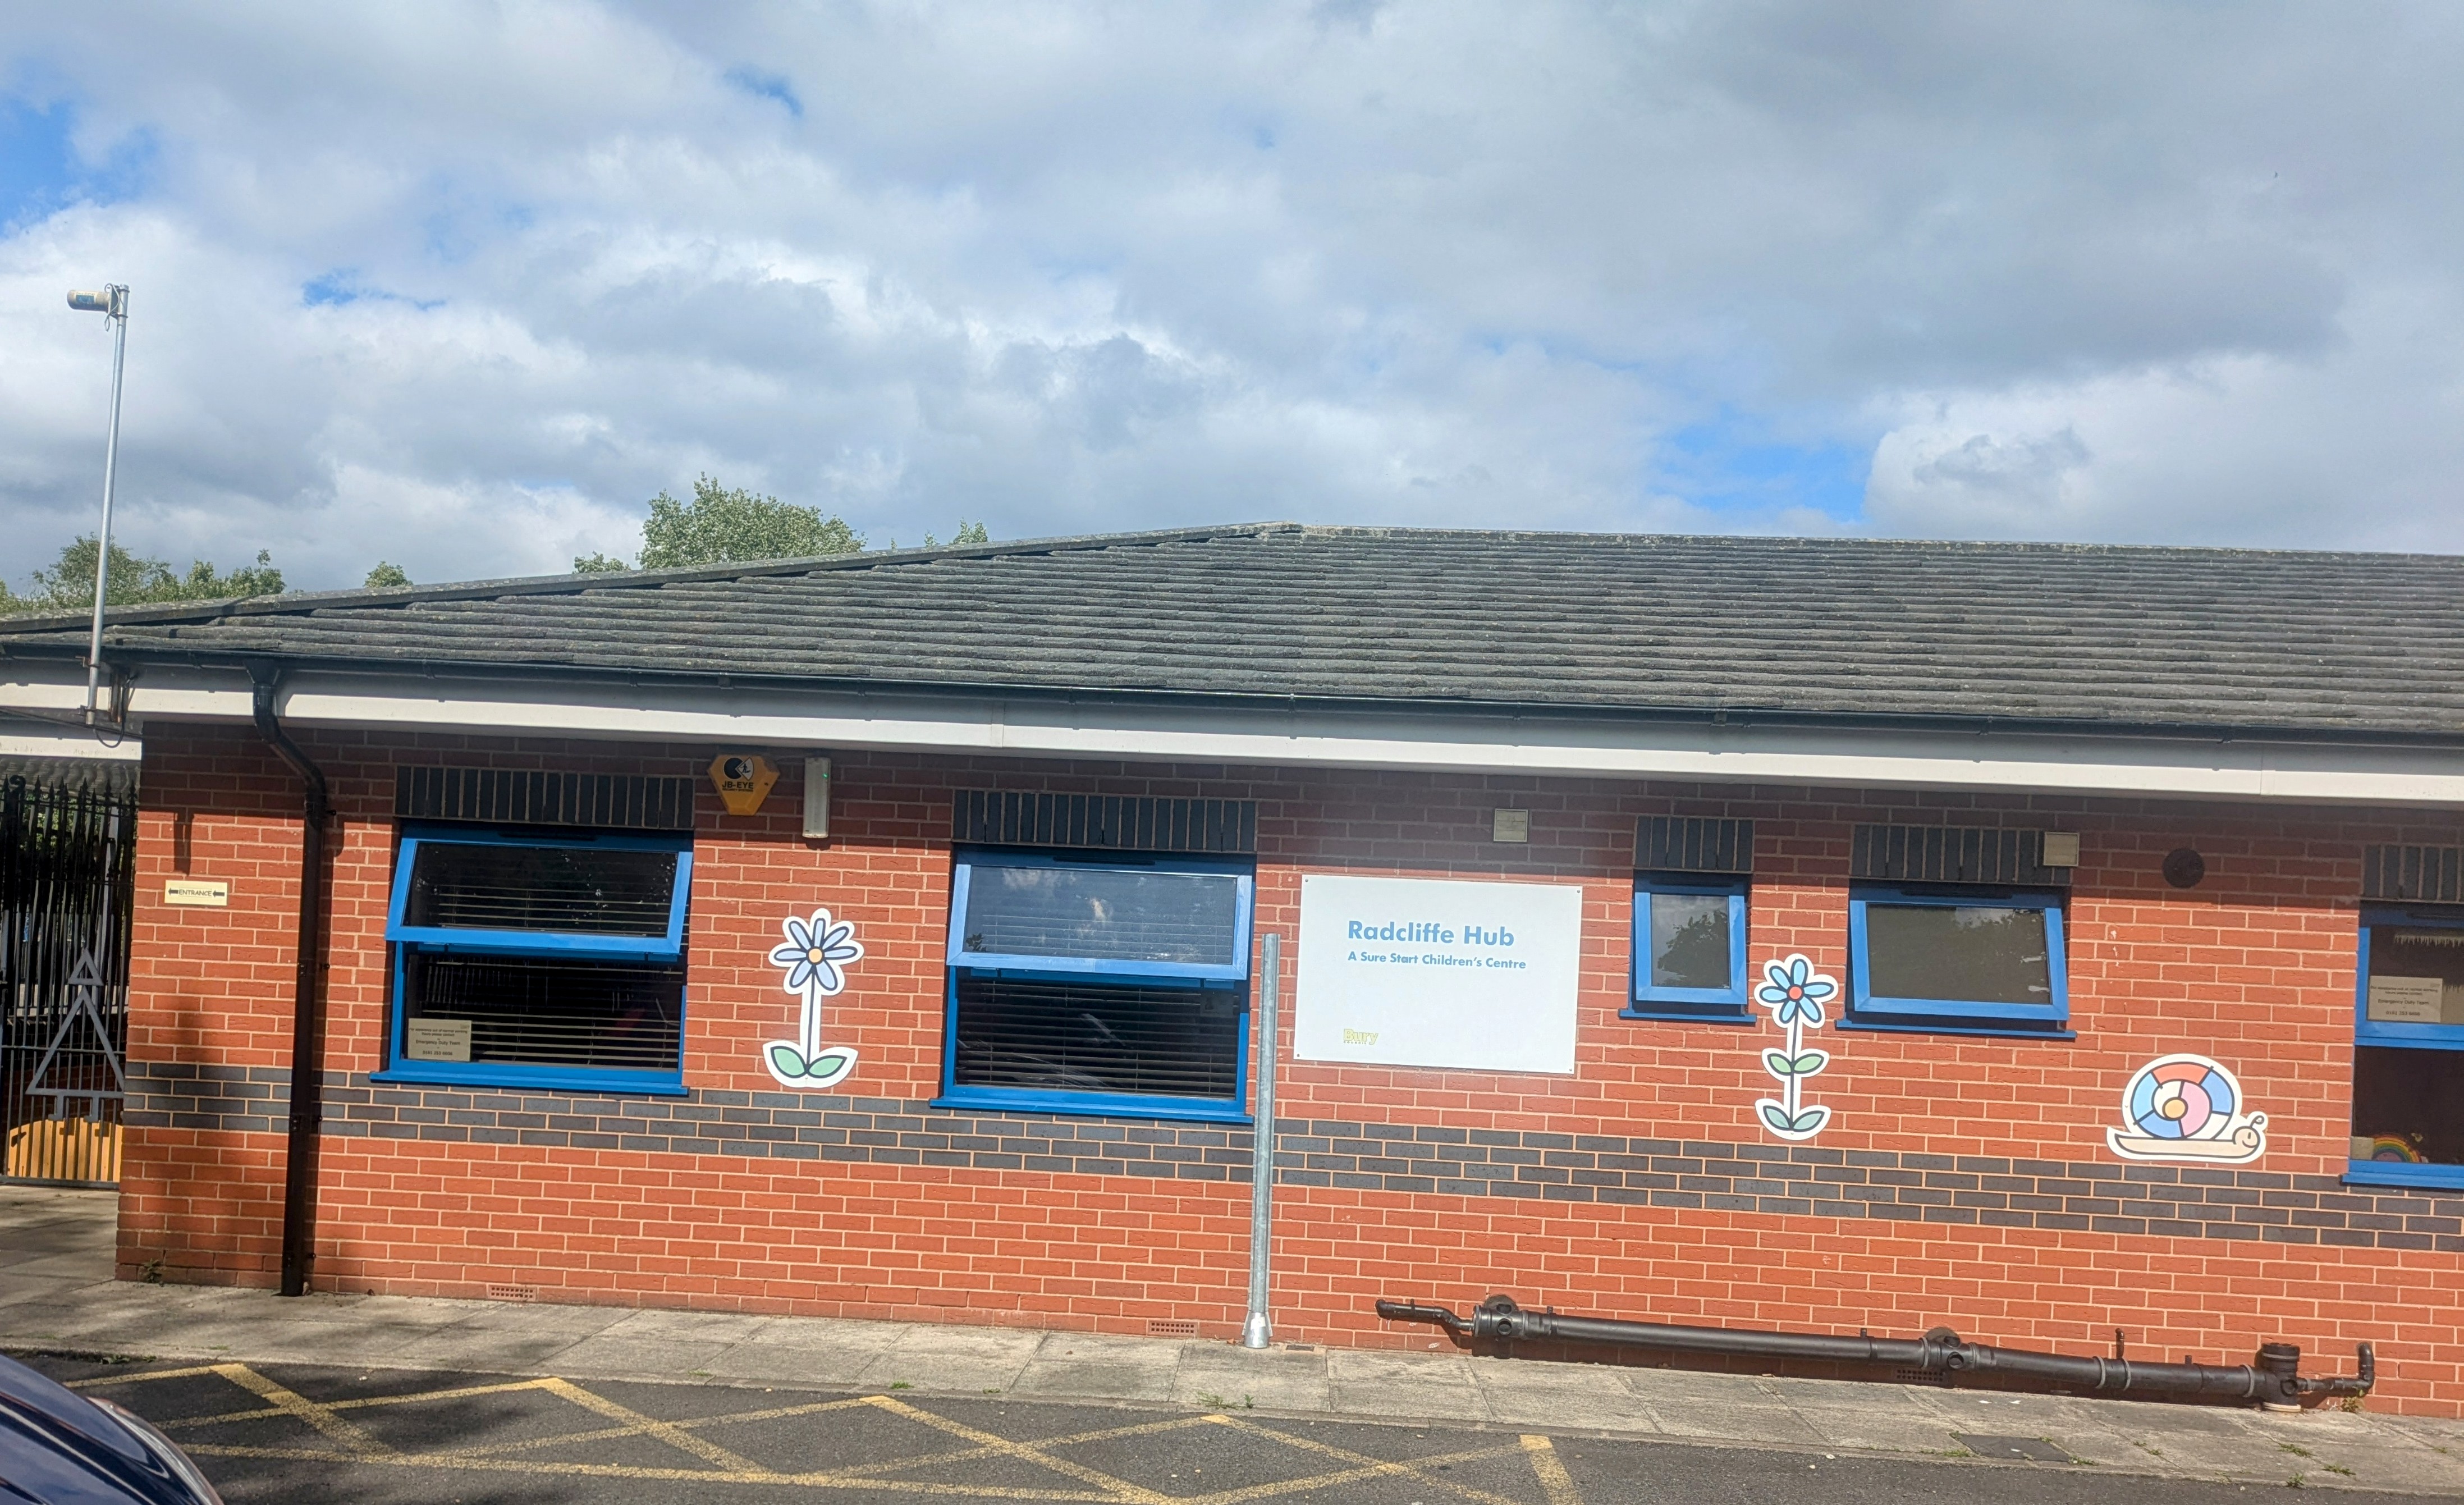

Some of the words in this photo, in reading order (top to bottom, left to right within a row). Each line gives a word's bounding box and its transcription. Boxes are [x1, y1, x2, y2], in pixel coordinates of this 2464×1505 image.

[1348, 921, 1454, 944] Radcliffe
[1464, 926, 1515, 946] Hub
[1348, 951, 1357, 961] A
[1361, 952, 1386, 962] Sure
[1390, 953, 1418, 964] Start
[1422, 954, 1482, 967] Children's
[1486, 958, 1526, 969] Centre
[1344, 1029, 1378, 1045] Bury
